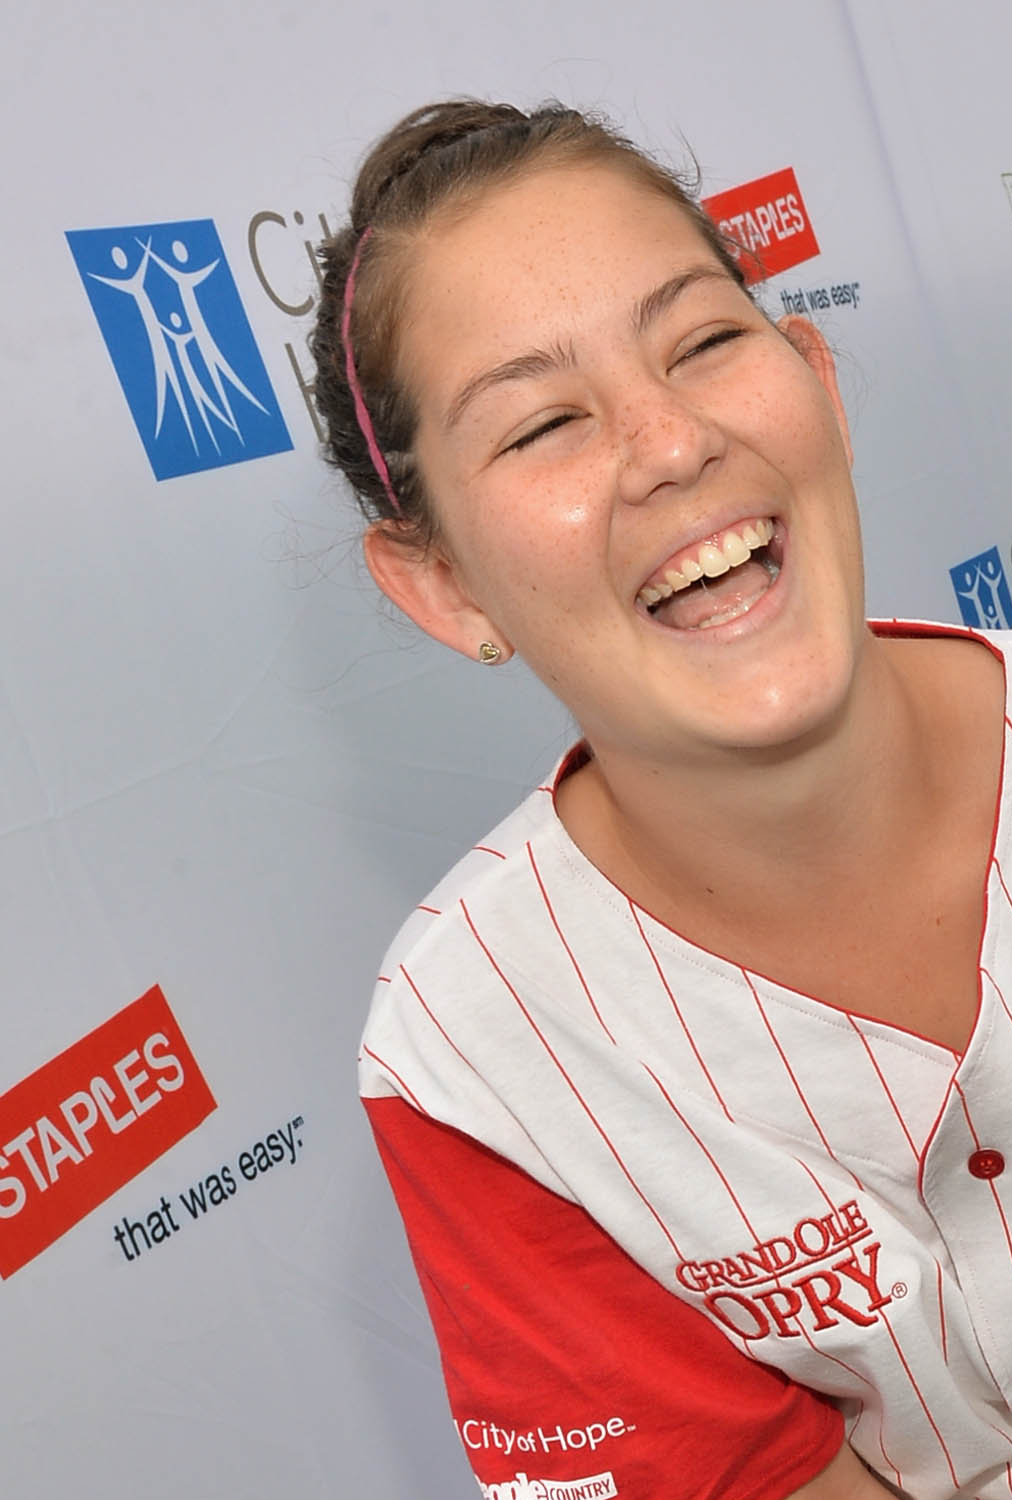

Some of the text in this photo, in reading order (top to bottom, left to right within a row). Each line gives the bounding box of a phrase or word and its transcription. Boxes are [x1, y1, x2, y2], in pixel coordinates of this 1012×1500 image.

[717, 193, 806, 260] STAPLES
[806, 285, 832, 312] was
[112, 1197, 181, 1263] that
[179, 1165, 238, 1220] was
[675, 1199, 869, 1292] GRAND OLE
[462, 1416, 628, 1455] City of Hope
